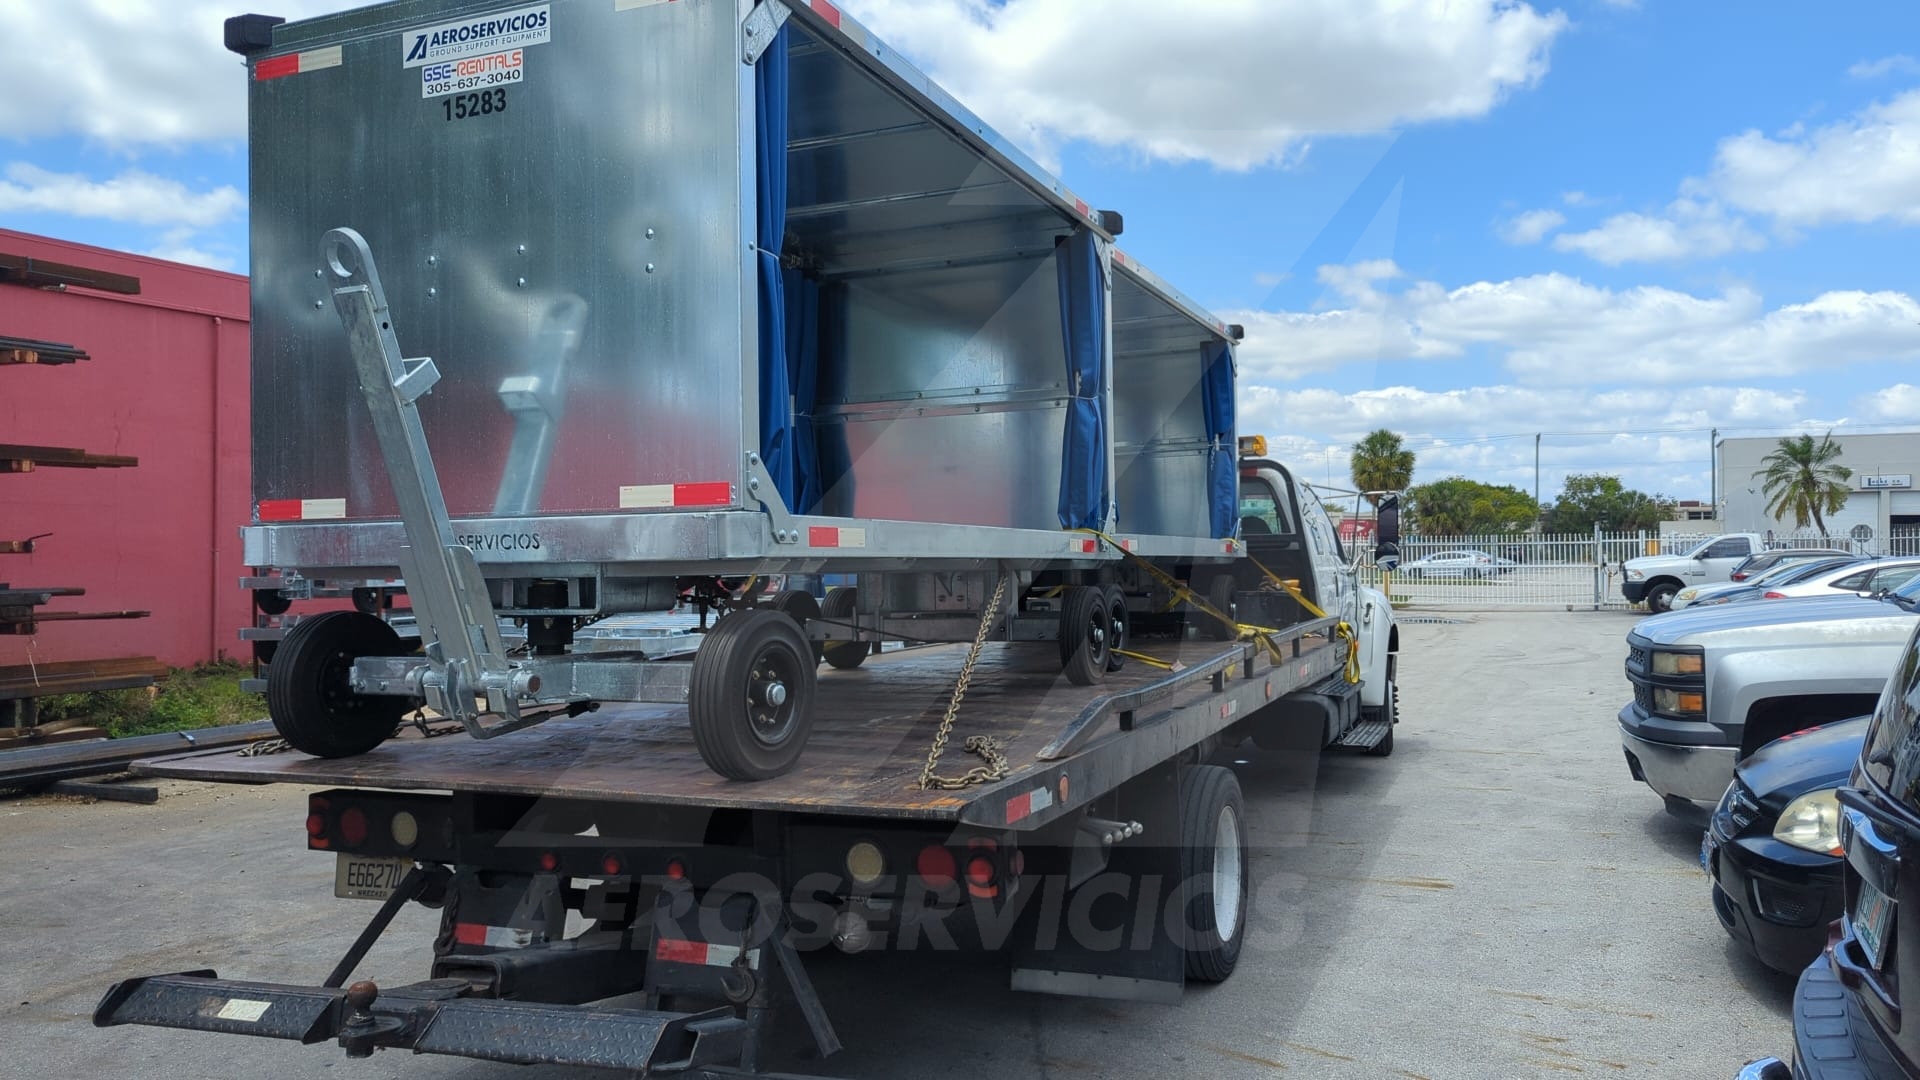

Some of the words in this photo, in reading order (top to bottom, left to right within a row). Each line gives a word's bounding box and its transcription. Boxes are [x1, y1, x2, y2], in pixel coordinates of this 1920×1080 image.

[430, 11, 547, 47] AEROSERVICIOS
[430, 45, 462, 58] GROUND
[465, 38, 499, 51] SUPPORT
[502, 30, 547, 45] EQUIPMENT
[423, 51, 522, 83] GSE-RENTALS
[426, 69, 521, 95] 305-637-3040
[442, 88, 507, 121] 15283
[457, 533, 541, 551] SERVICIOS
